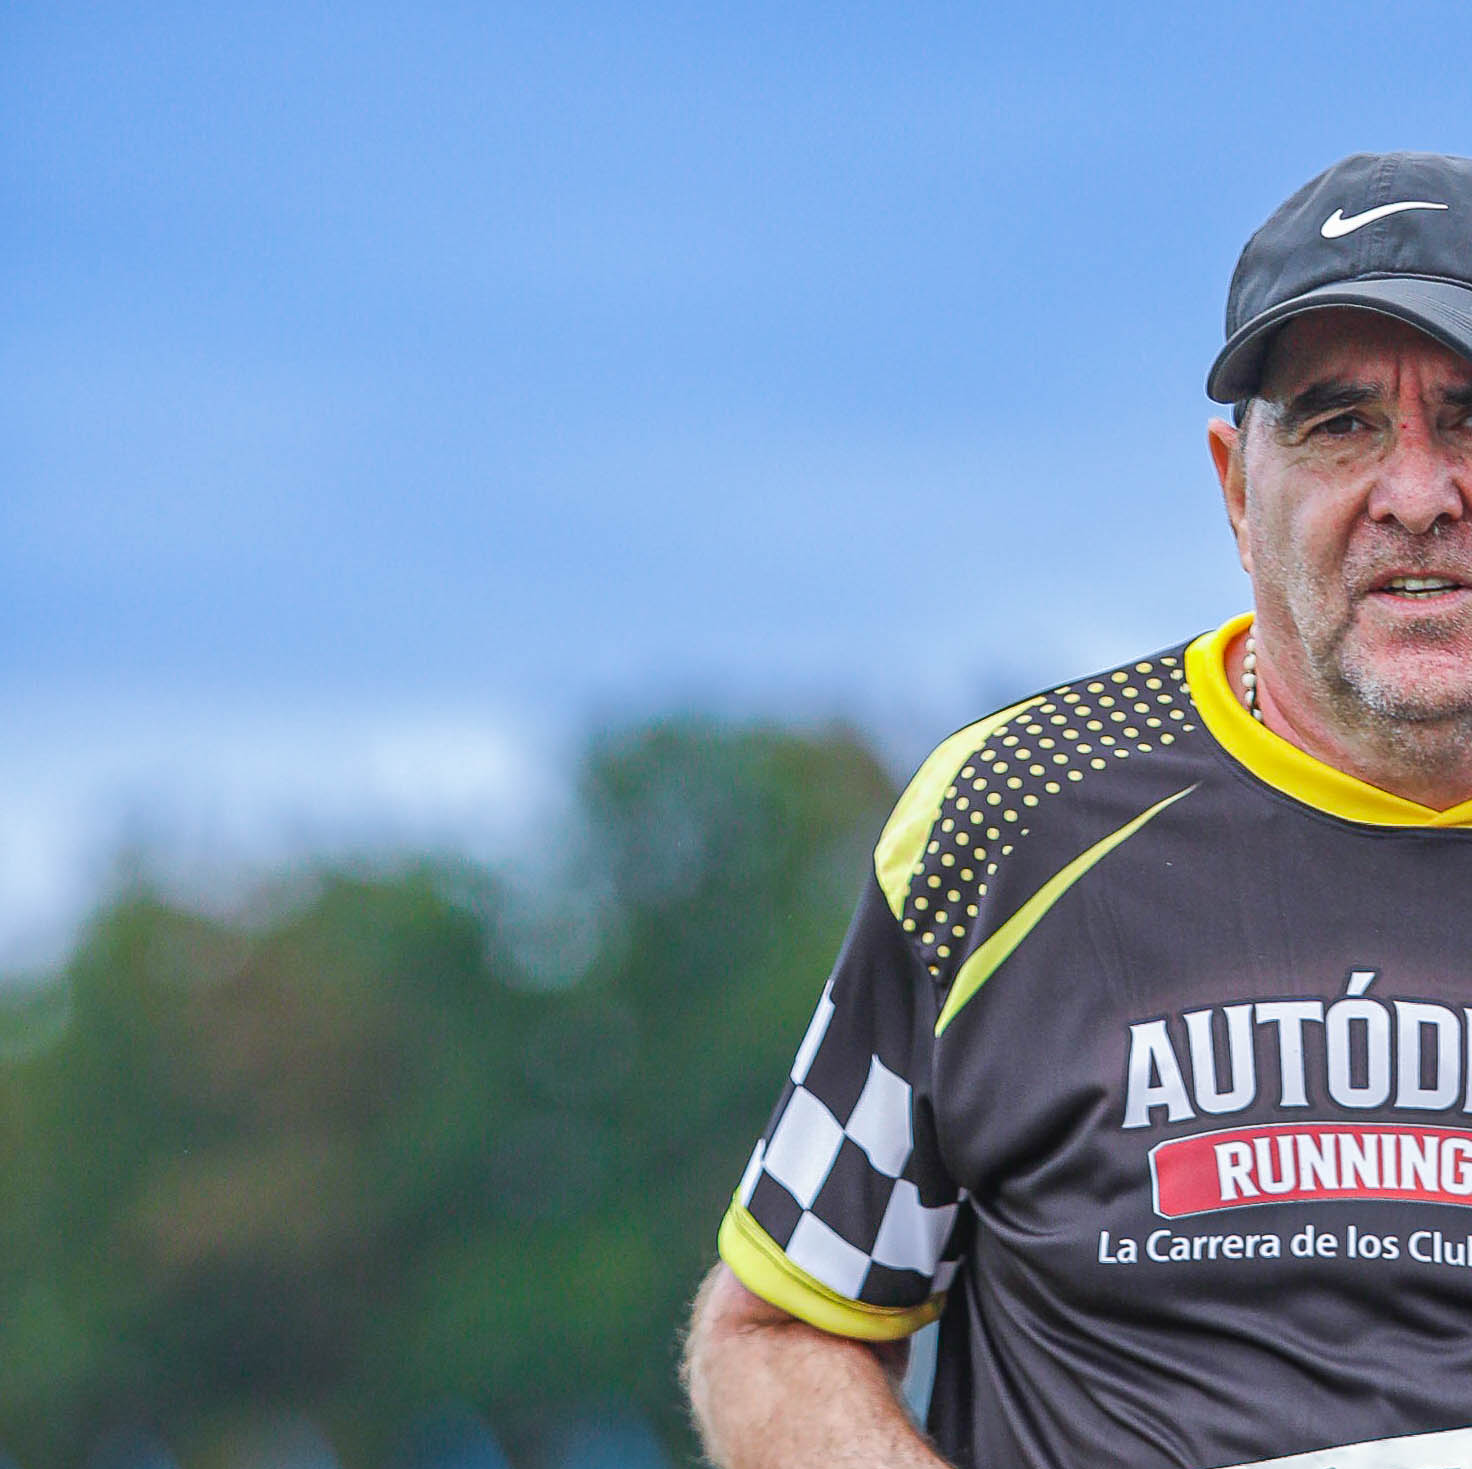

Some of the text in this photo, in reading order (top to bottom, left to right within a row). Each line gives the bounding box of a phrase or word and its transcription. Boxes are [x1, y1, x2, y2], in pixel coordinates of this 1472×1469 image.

[1099, 1230, 1138, 1264] La
[1146, 1228, 1281, 1263] Carrera
[1290, 1224, 1338, 1258] de
[1347, 1225, 1400, 1261] los
